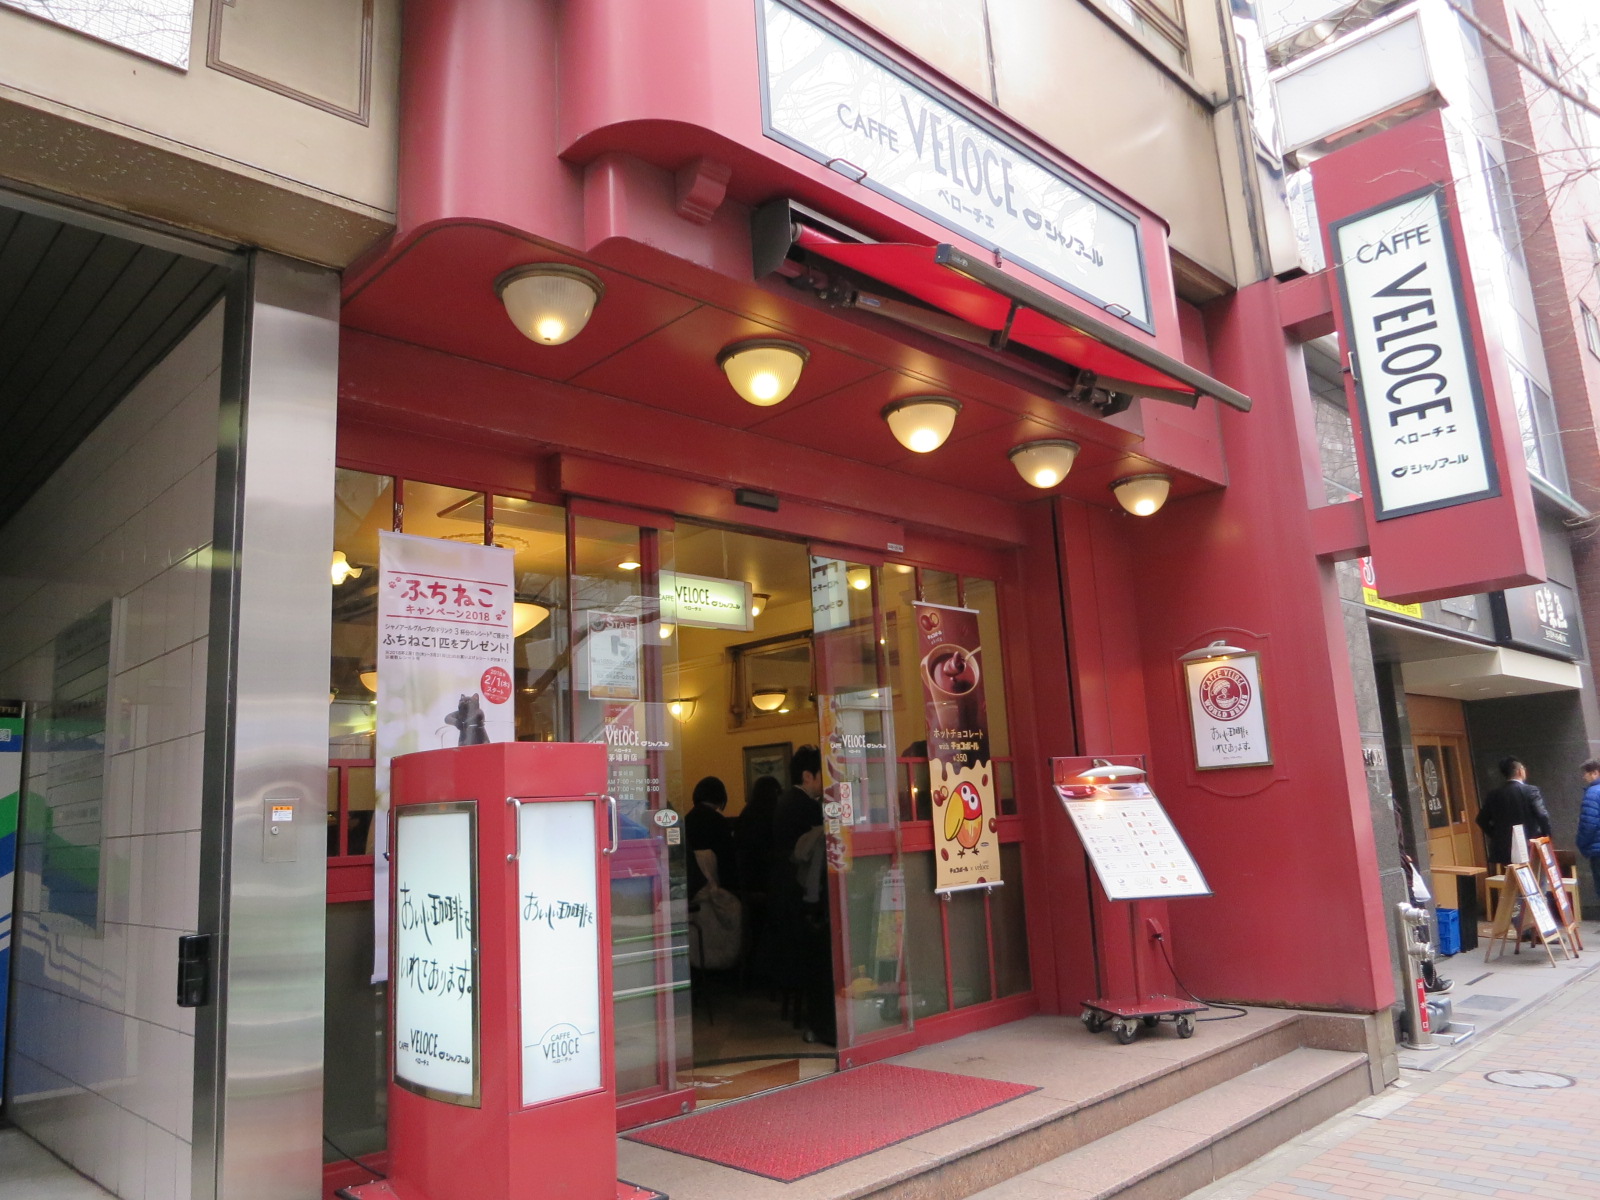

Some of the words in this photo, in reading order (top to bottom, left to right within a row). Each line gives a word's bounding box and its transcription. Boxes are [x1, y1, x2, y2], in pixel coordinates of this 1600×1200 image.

[837, 102, 900, 154] CAFFE
[900, 94, 1018, 218] VELOCE
[938, 188, 996, 230] ベローチェ
[1045, 221, 1104, 268] シャノアール
[1356, 223, 1431, 265] CAFFE
[1370, 261, 1453, 428] VELOCE
[1410, 453, 1469, 476] シャノアール
[401, 579, 494, 608] ふちねこ
[675, 585, 710, 605] VELOCE
[405, 604, 491, 622] キャンペーン2018
[1204, 699, 1228, 718] WORLD
[605, 730, 639, 746] VELOCE
[841, 734, 866, 748] VELOCE
[933, 728, 983, 739] ホットチョコレート
[410, 1028, 438, 1058] VELOCE
[550, 1031, 571, 1042] CAFFE
[542, 1037, 580, 1060] VELOCE
